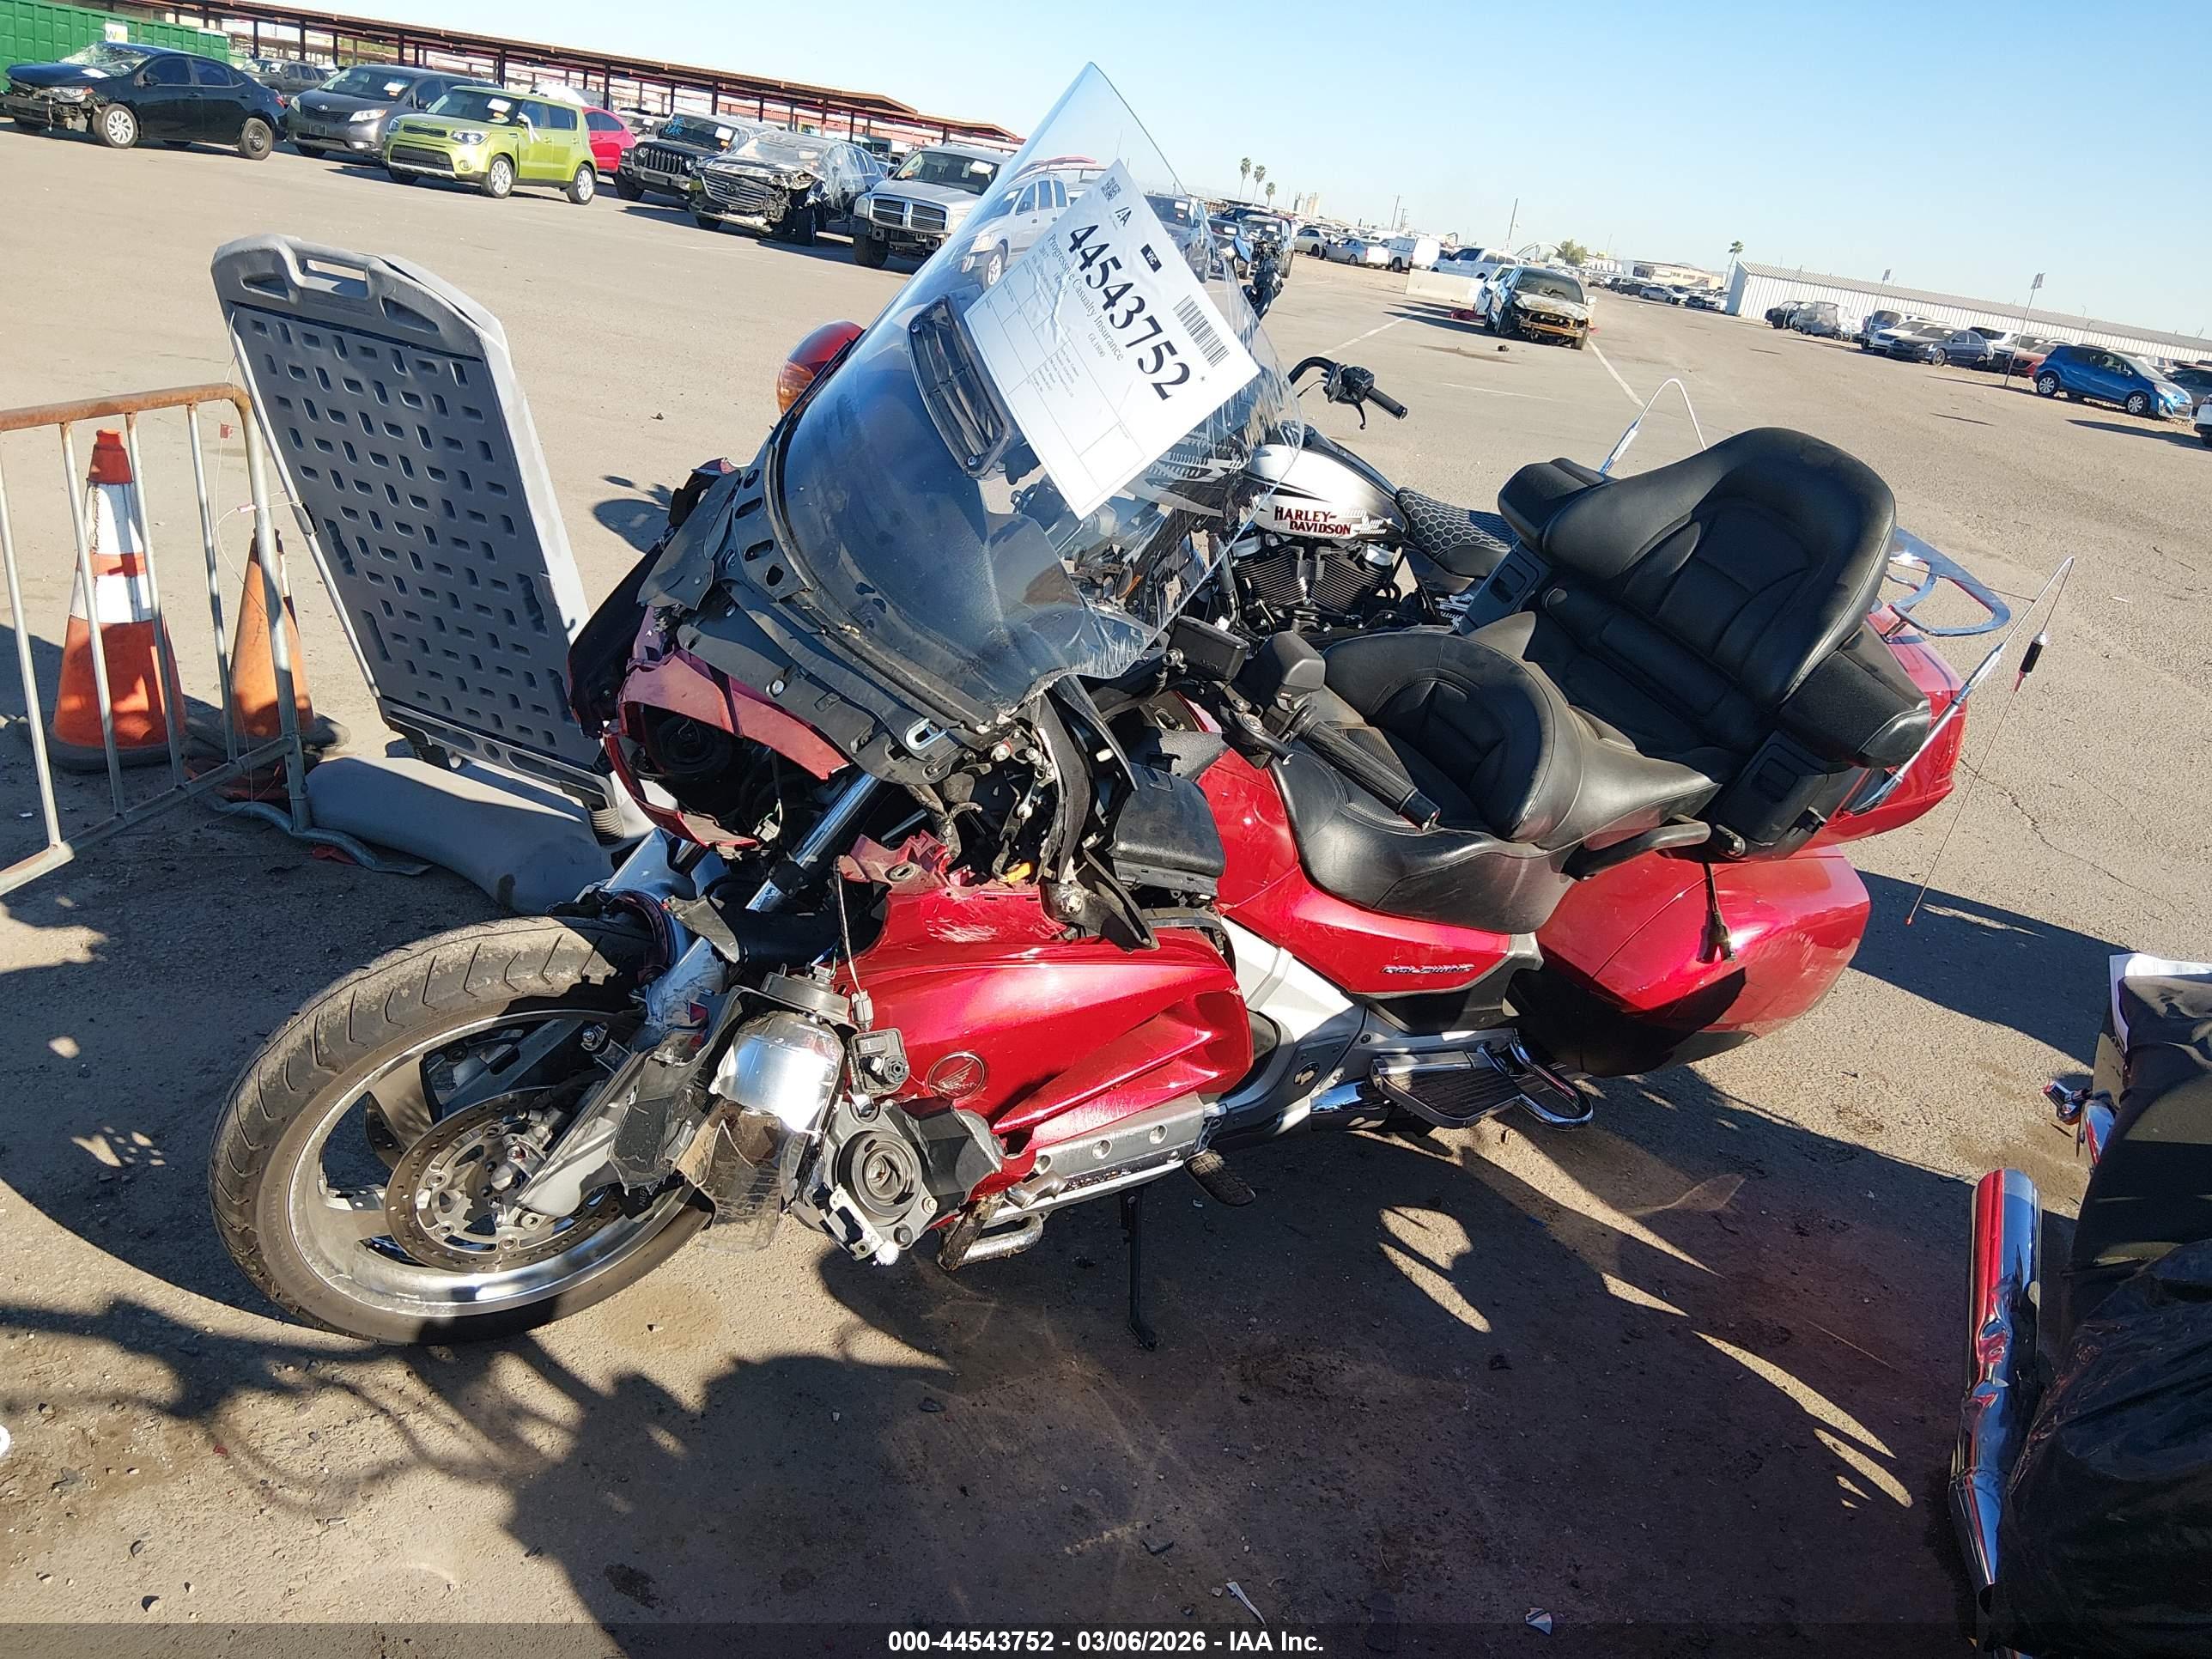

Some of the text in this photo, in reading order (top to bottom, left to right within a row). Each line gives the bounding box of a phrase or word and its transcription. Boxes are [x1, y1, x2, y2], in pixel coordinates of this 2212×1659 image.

[1146, 250, 1158, 265] VIC
[1047, 233, 1124, 362] Progressive Casualty Insurance
[1068, 224, 1190, 401] 44543752
[1087, 333, 1106, 358] GL1800
[1274, 505, 1336, 523] HARLEY-
[1290, 520, 1352, 534] DAVIDSON
